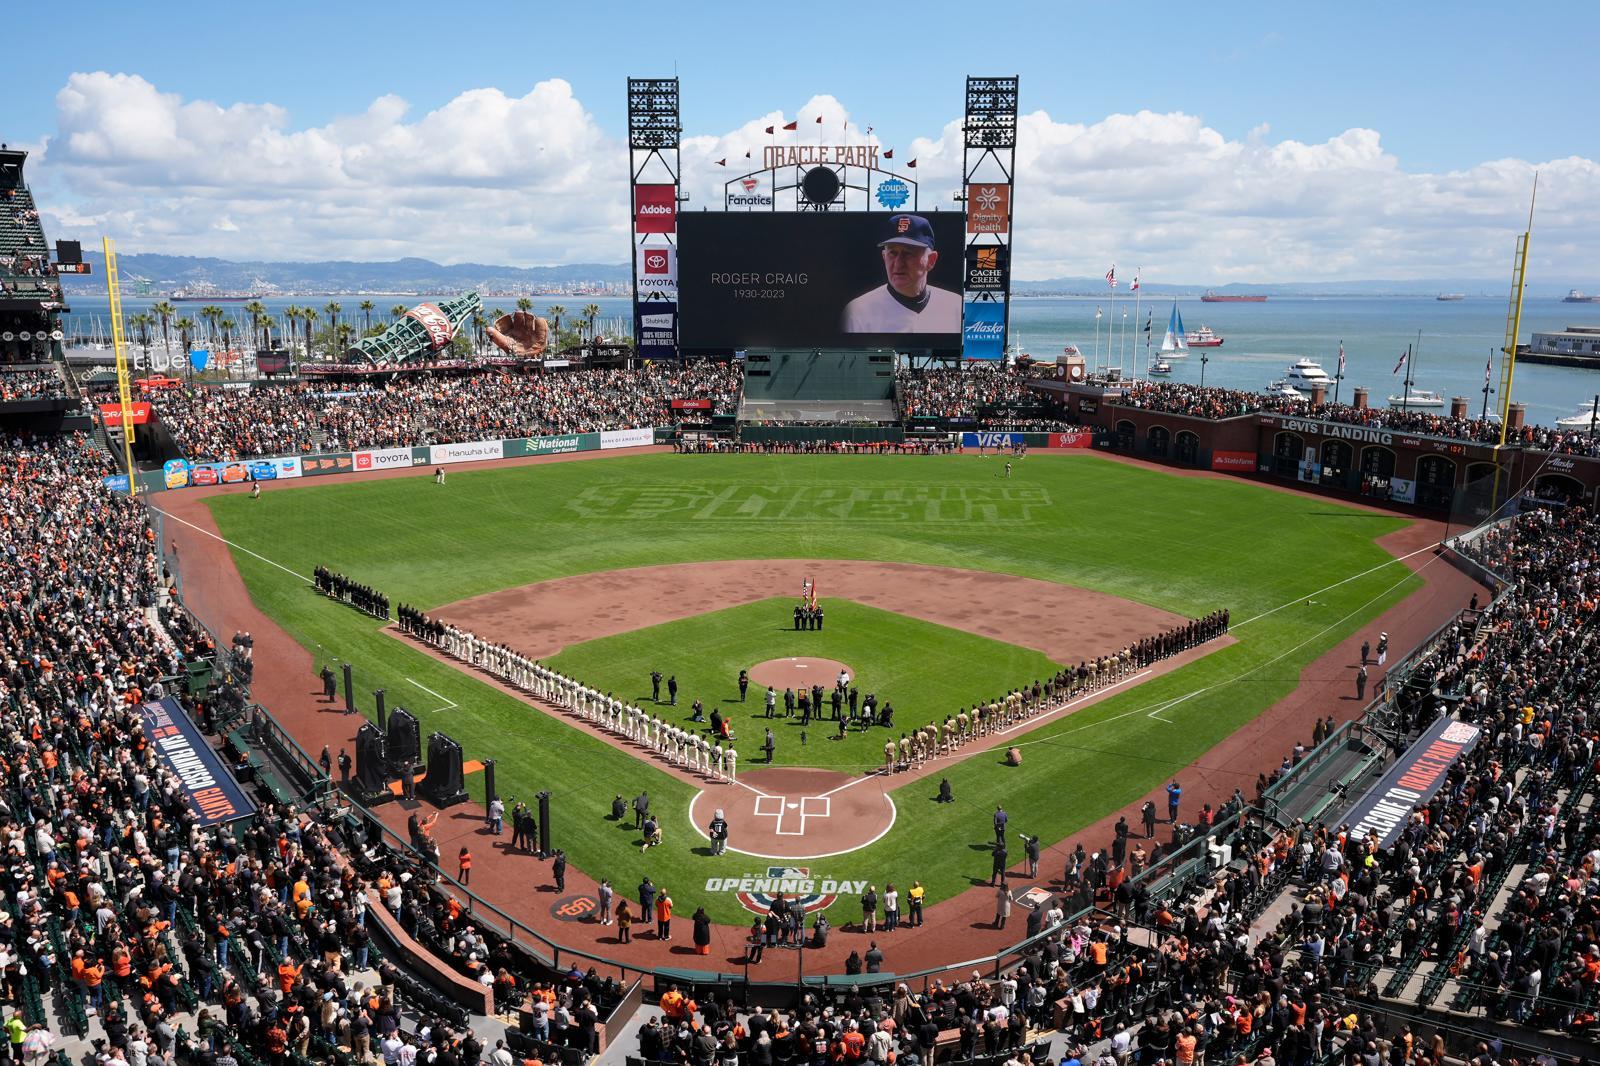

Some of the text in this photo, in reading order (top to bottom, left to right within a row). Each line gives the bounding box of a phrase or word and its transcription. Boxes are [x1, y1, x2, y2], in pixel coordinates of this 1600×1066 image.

[764, 146, 879, 170] ORACLE PARK
[881, 185, 906, 194] coupa
[728, 194, 771, 206] Fanatics
[640, 205, 672, 214] Adobe
[973, 213, 1002, 223] Dignity
[974, 223, 1001, 231] Health
[57, 264, 66, 272] WE
[66, 264, 76, 272] ARE
[639, 279, 674, 287] TOYOTA
[711, 273, 808, 284] ROGER CRAIG
[734, 289, 785, 298] 1930-2023
[965, 321, 1004, 333] Alaska
[643, 331, 672, 339] 100% VERIFIED
[657, 338, 674, 346] TICKETS
[133, 351, 186, 371] blue
[1281, 419, 1319, 434] Levi's
[1323, 424, 1393, 446] LANDING
[539, 436, 579, 449] National
[975, 433, 1012, 447] VISA
[449, 446, 500, 457] Hanwha Life
[374, 454, 410, 464] TOYOTA
[159, 734, 190, 751] SAN
[1422, 740, 1463, 763] PARK
[167, 747, 216, 790] FRANCISCO
[1397, 758, 1447, 791] ORACLE
[1385, 787, 1421, 803] TO
[192, 787, 236, 820] GIANTS
[1350, 798, 1411, 845] WELCOME
[704, 878, 868, 895] OPENING DAY
